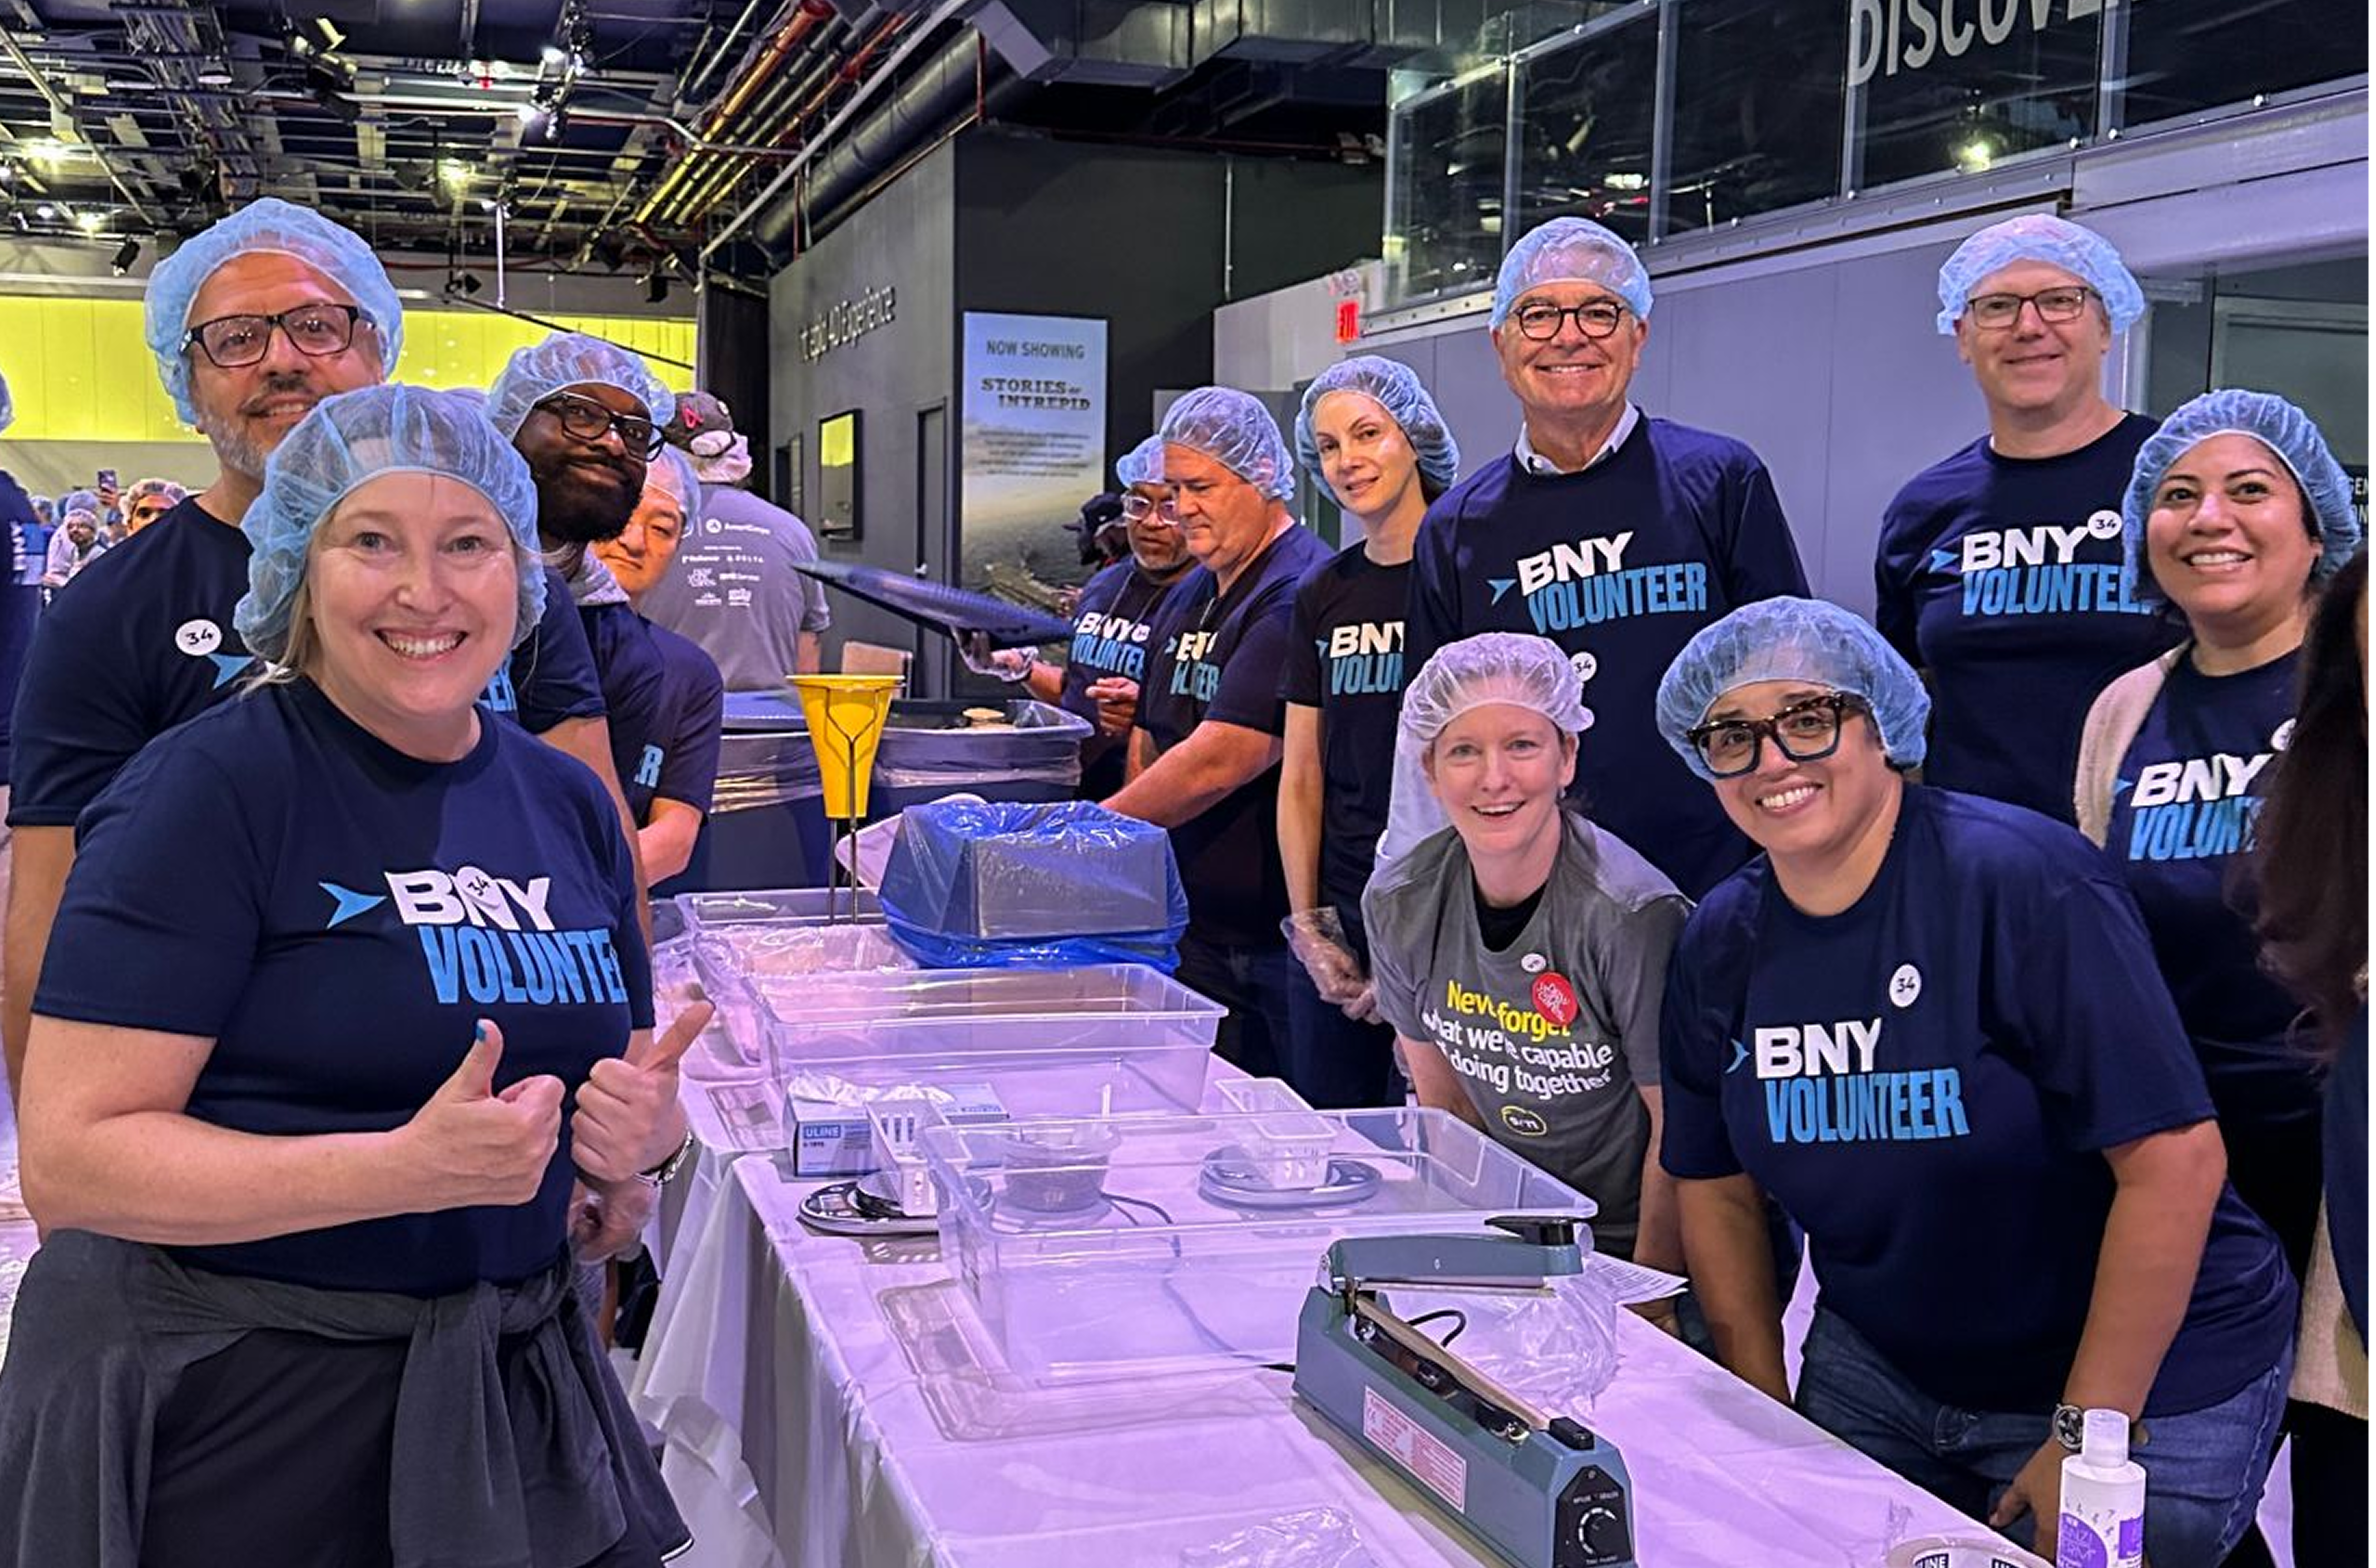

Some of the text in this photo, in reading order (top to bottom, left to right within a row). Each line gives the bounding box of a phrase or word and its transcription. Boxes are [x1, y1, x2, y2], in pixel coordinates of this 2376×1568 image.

[986, 340, 1085, 359] NOW SHOWING
[981, 378, 1066, 394] STORIES
[998, 394, 1091, 411] INTREPID
[2096, 518, 2116, 530] 34
[1961, 526, 2089, 572] BNY
[1517, 531, 1633, 597] BNY
[1528, 562, 1706, 635] VOLUNTEER
[186, 628, 214, 646] 34
[1075, 612, 1136, 641] BNY
[1573, 659, 1592, 673] 34
[2130, 753, 2273, 807] BNY
[384, 869, 555, 931] BNY
[467, 876, 490, 897] 34
[1897, 977, 1916, 993] 34
[1521, 1043, 1614, 1072] capable
[1755, 1017, 1882, 1079] BNY
[1451, 1049, 1510, 1093] doing
[1514, 1065, 1612, 1100] together
[1765, 1068, 1970, 1143] VOLUNTEER
[805, 1127, 839, 1137] ULINE
